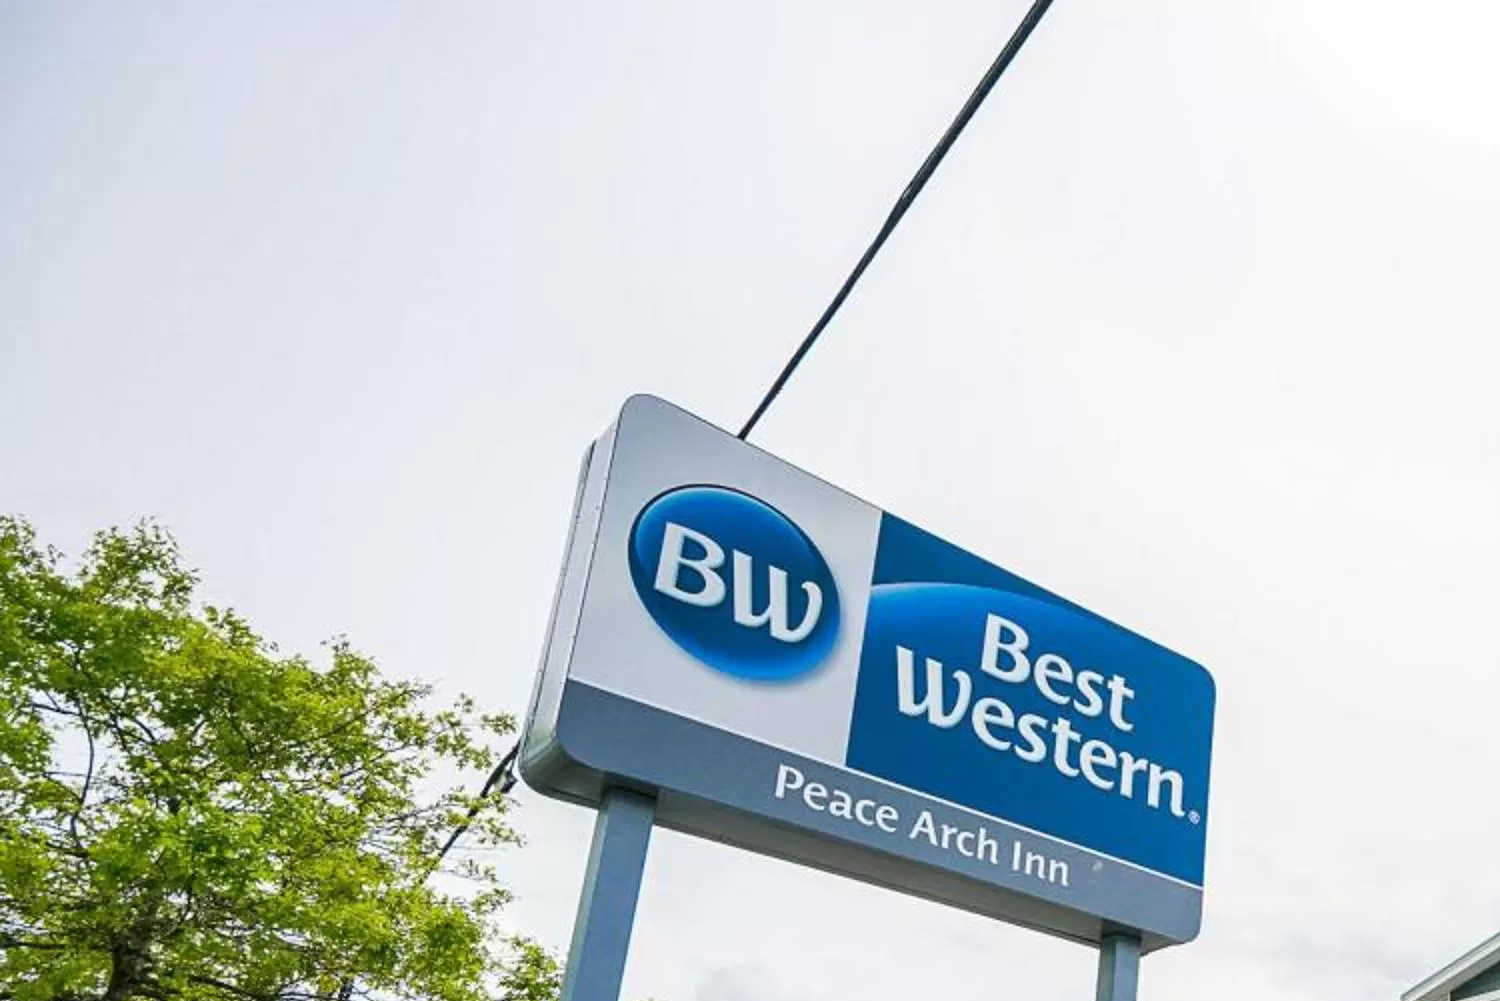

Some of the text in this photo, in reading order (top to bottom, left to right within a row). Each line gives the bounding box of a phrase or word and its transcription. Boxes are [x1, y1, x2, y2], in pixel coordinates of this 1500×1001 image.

[655, 522, 823, 643] BW
[896, 645, 1186, 818] Western
[981, 613, 1135, 733] Best
[774, 764, 1069, 887] Peace Arch Inn
